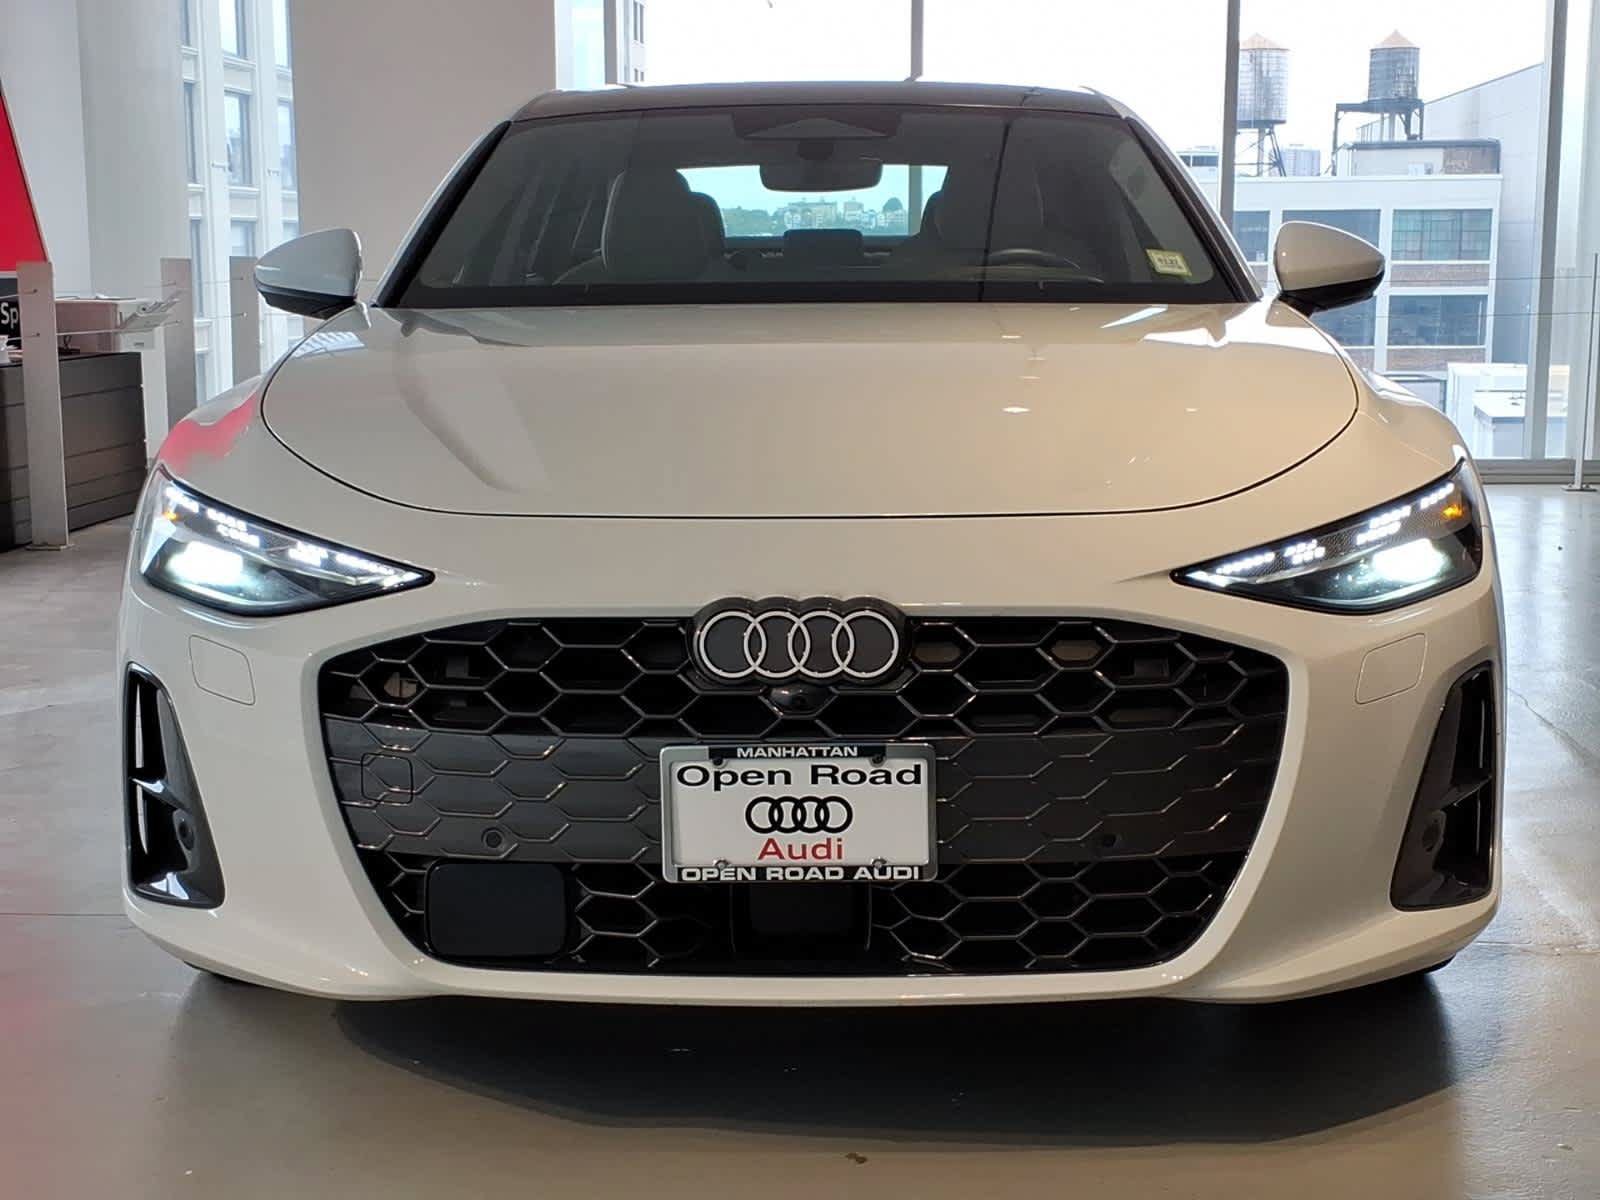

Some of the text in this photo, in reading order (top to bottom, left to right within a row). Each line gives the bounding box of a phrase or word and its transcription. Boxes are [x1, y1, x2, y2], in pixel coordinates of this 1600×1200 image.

[736, 746, 858, 758] MANHATTAN
[677, 764, 922, 791] Open Road
[757, 838, 843, 860] Audi
[681, 867, 919, 881] OPEN ROAD AUDI
